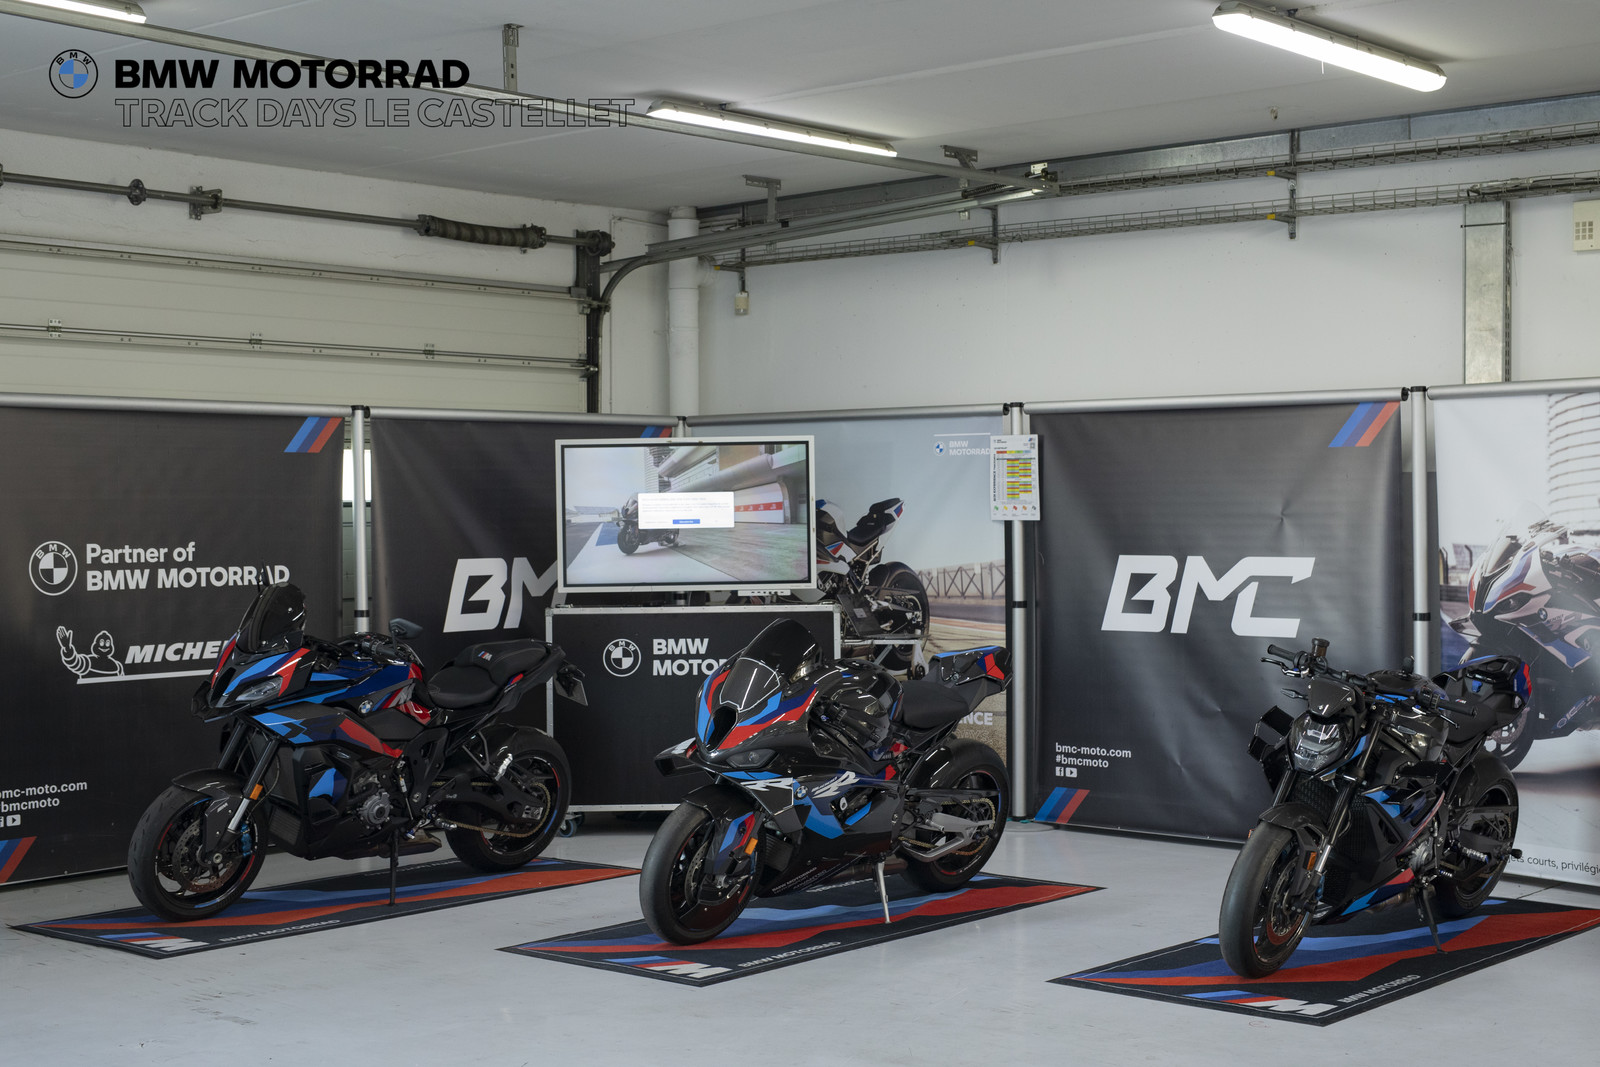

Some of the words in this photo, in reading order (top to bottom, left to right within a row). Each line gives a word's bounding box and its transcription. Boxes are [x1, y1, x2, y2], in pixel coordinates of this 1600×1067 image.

[949, 448, 990, 456] MOTORRAD
[35, 543, 71, 559] BMW
[86, 544, 168, 565] Partner
[173, 542, 196, 562] of
[86, 569, 149, 591] BMW
[1101, 555, 1316, 638] BMC
[125, 640, 228, 664] MICHE
[608, 640, 636, 652] BMW
[653, 638, 709, 655] BMW
[653, 659, 727, 676] MOTO
[959, 712, 993, 725] NCE
[1055, 742, 1132, 758] bmc-moto.com
[1055, 754, 1109, 768] #bmcmoto
[1527, 856, 1558, 869] courts,
[1561, 861, 1600, 875] privilégi
[771, 941, 841, 959] MOTORRAD
